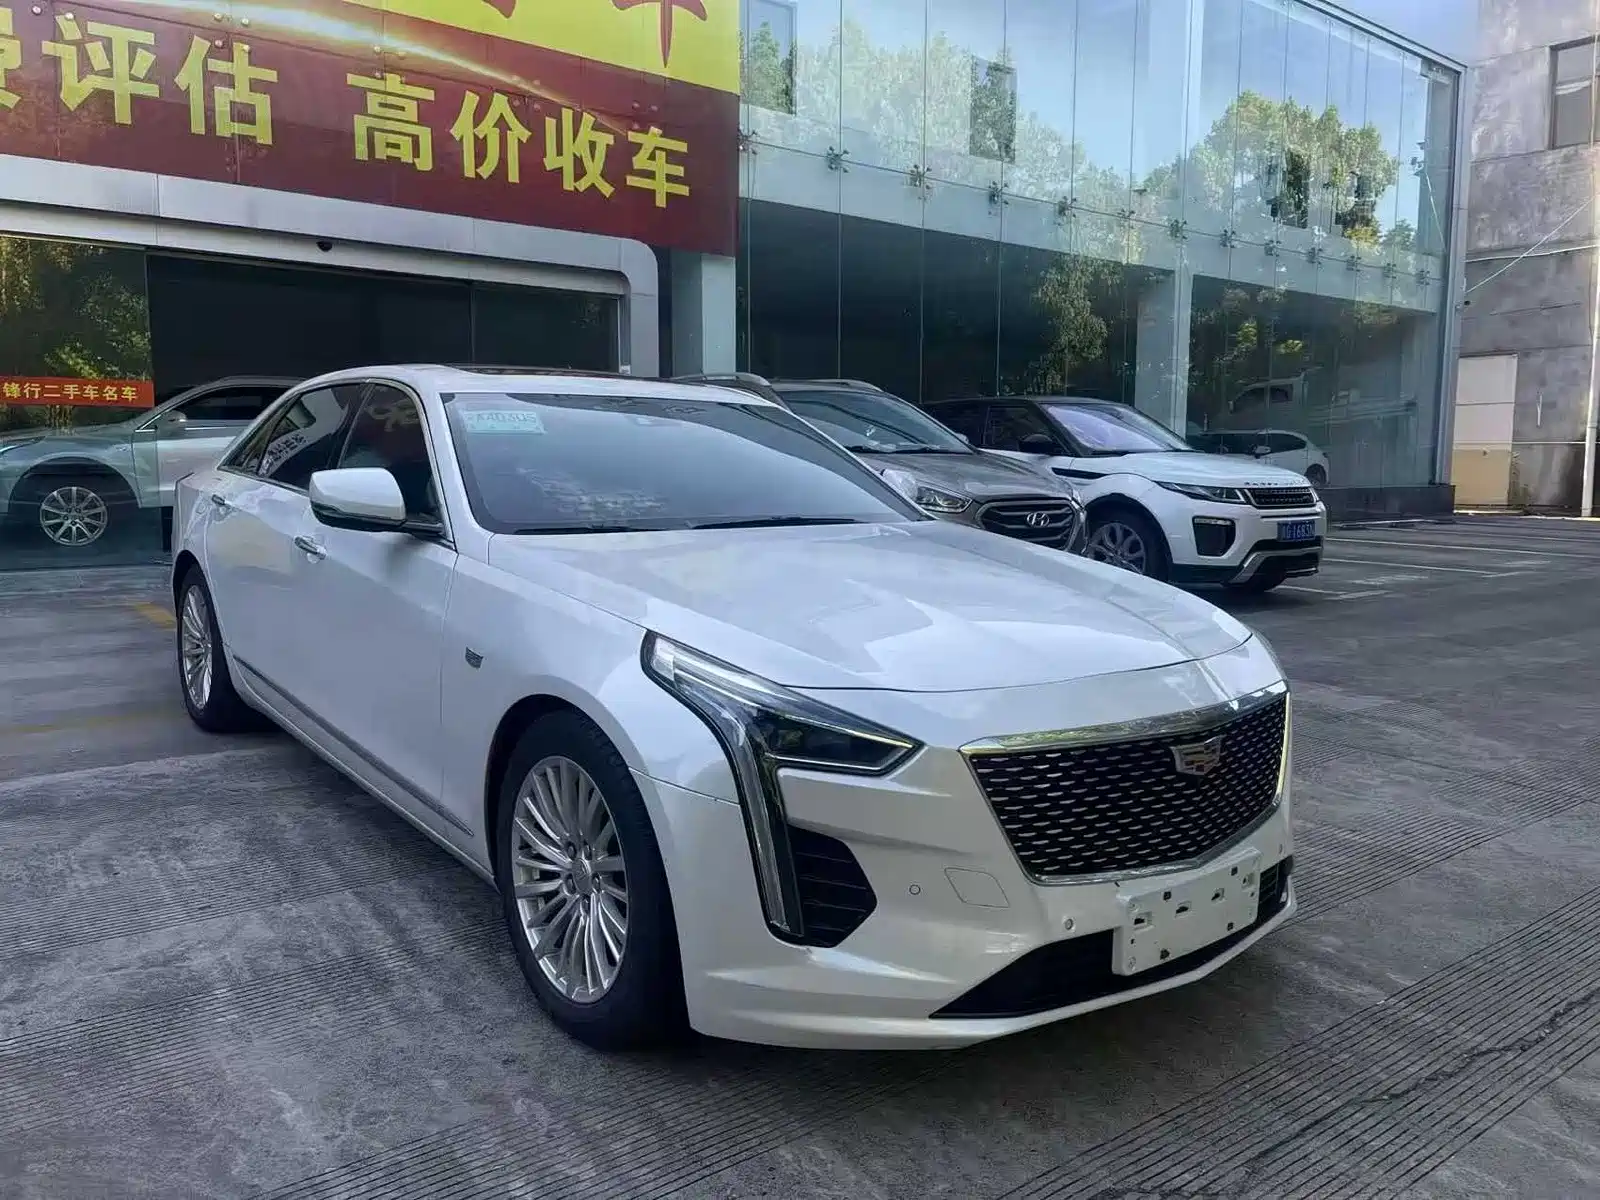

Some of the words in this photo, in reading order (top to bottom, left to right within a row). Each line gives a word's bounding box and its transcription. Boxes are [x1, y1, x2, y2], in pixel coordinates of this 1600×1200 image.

[346, 73, 691, 208] 高价收车
[2, 382, 138, 401] 锋行二手车名车
